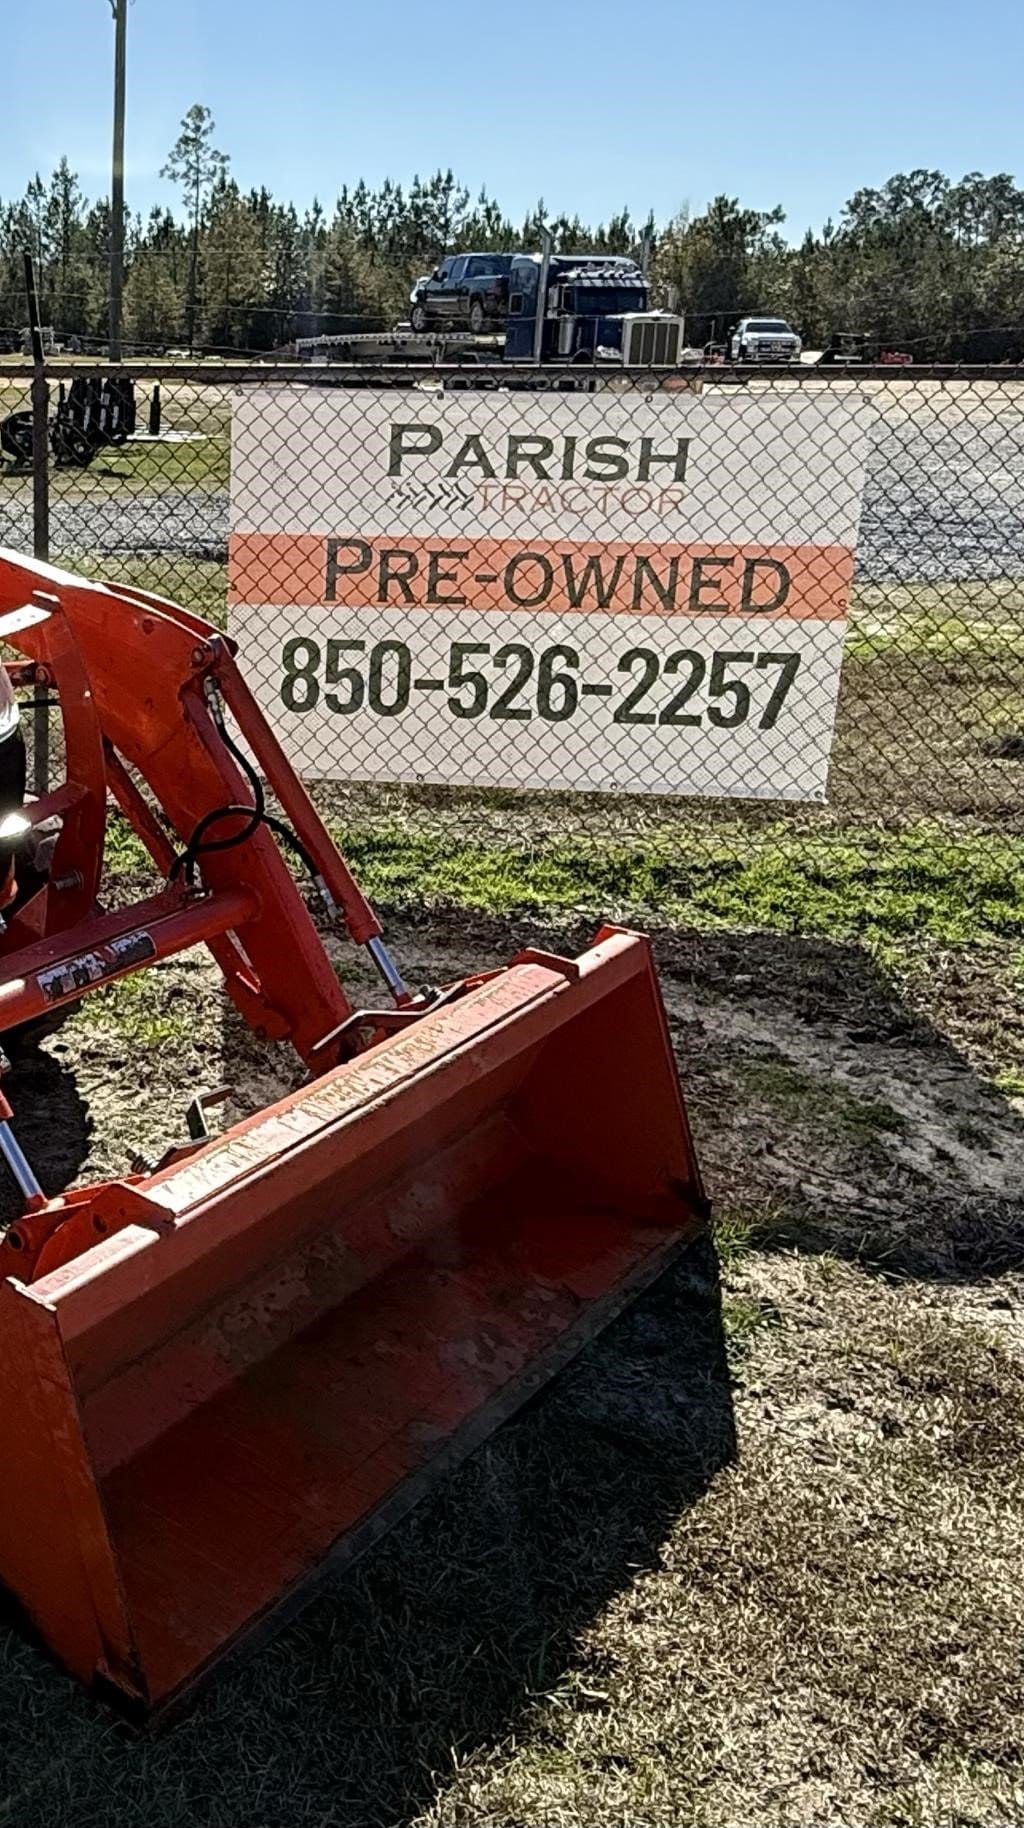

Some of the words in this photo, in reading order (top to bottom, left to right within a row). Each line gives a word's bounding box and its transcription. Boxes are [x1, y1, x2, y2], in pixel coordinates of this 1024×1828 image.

[386, 423, 692, 483] PARISH
[475, 484, 687, 516] TRACTOR
[323, 537, 791, 614] PRE-OWNED
[280, 636, 801, 730] 850-526-2257
